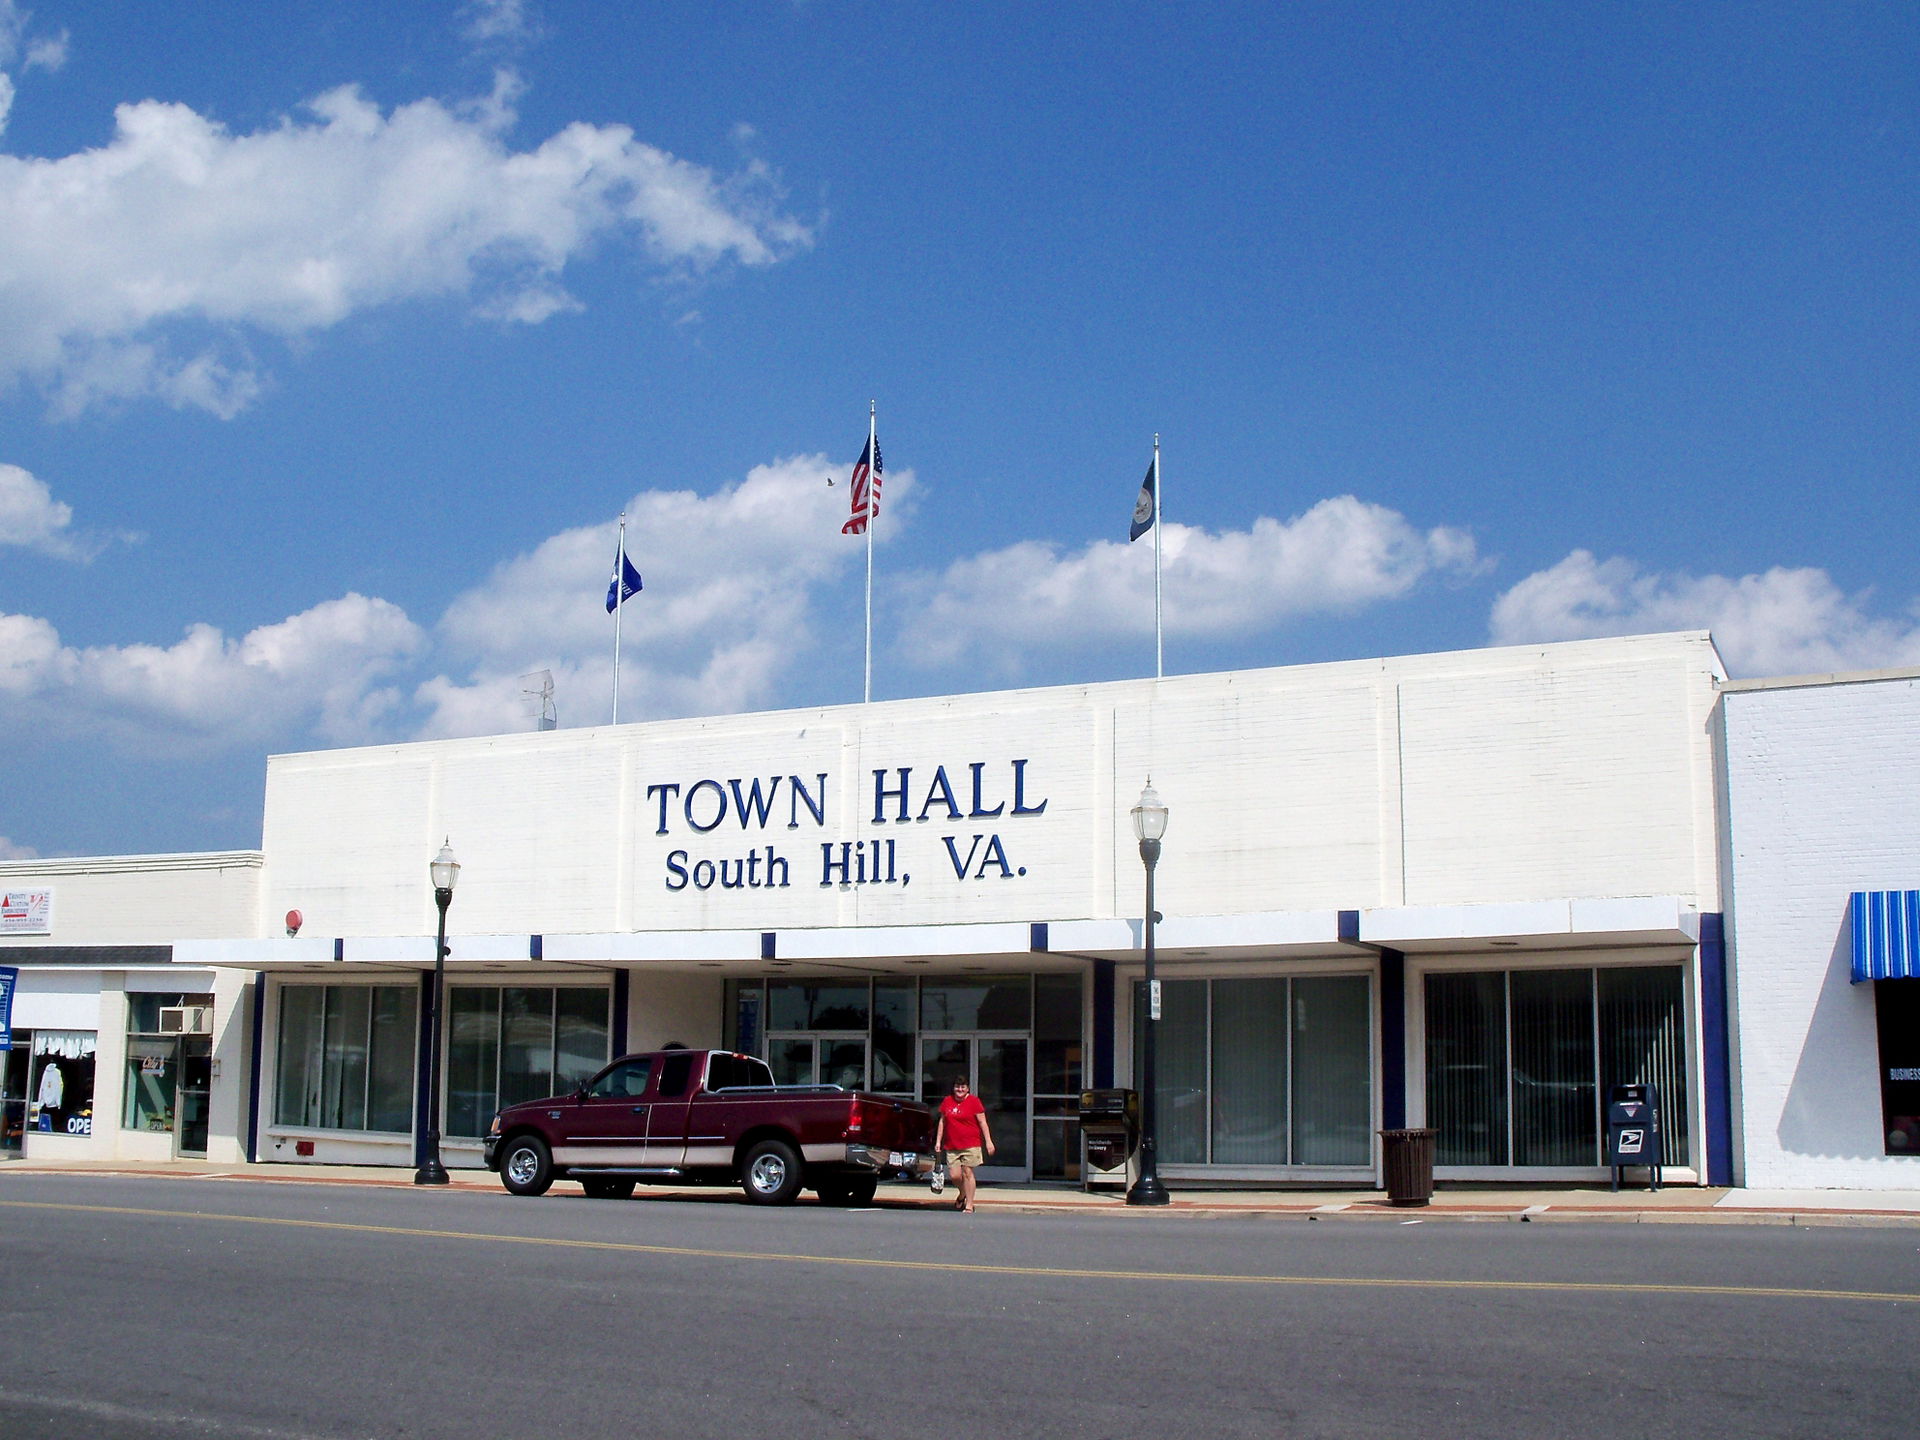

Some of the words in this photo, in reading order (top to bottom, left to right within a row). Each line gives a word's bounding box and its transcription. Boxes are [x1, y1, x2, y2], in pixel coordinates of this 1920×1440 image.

[647, 773, 828, 836] TOWN
[871, 759, 1049, 824] HALL
[665, 846, 790, 891] South
[820, 839, 910, 888] Hill,
[941, 834, 1028, 881] VA.
[67, 1117, 91, 1134] OPE
